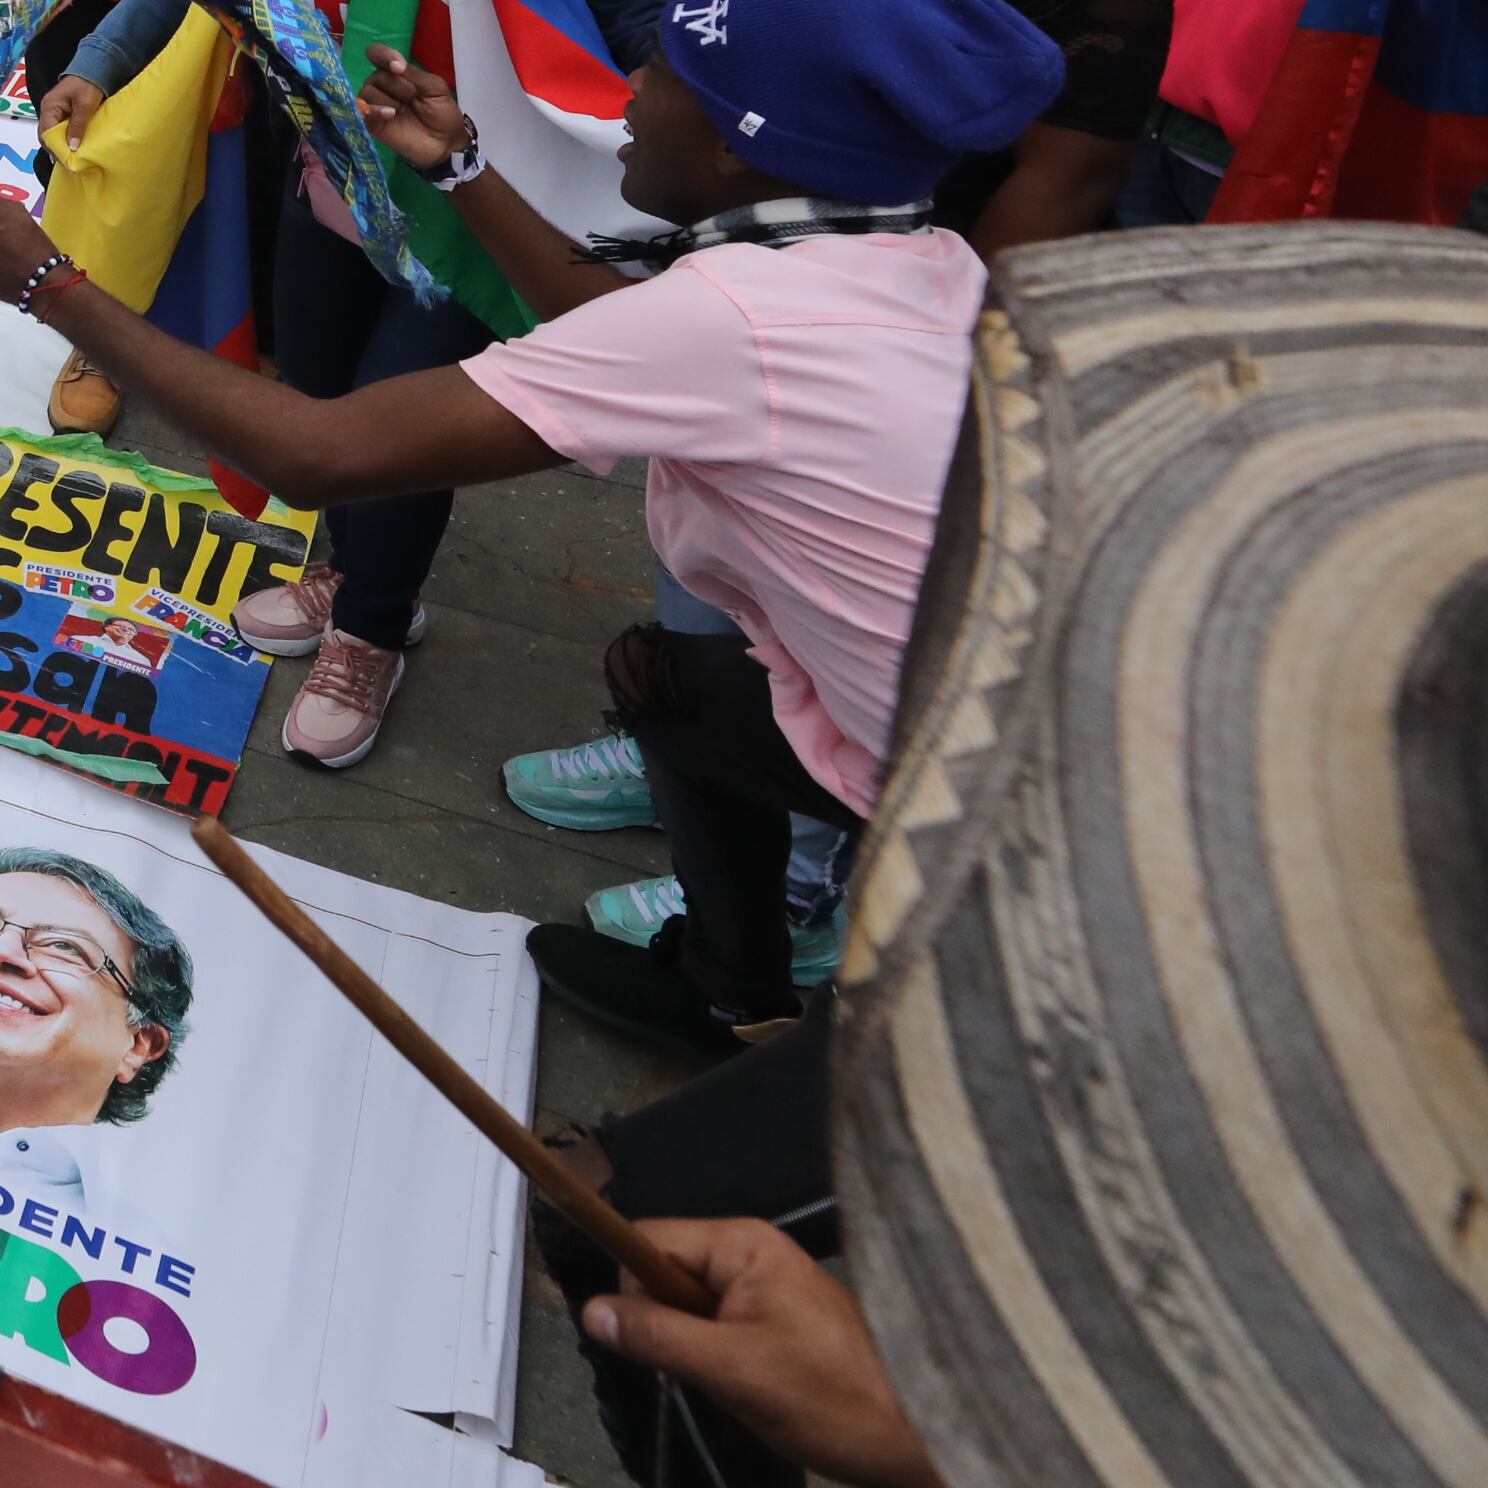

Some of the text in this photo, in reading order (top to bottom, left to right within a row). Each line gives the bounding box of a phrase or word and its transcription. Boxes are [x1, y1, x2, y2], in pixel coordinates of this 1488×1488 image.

[25, 571, 116, 603] PETRO
[26, 563, 113, 587] PRESIDENTE
[132, 594, 255, 663] FRANCIA
[54, 632, 105, 658] PETRO
[102, 654, 153, 677] PRESIDENTE
